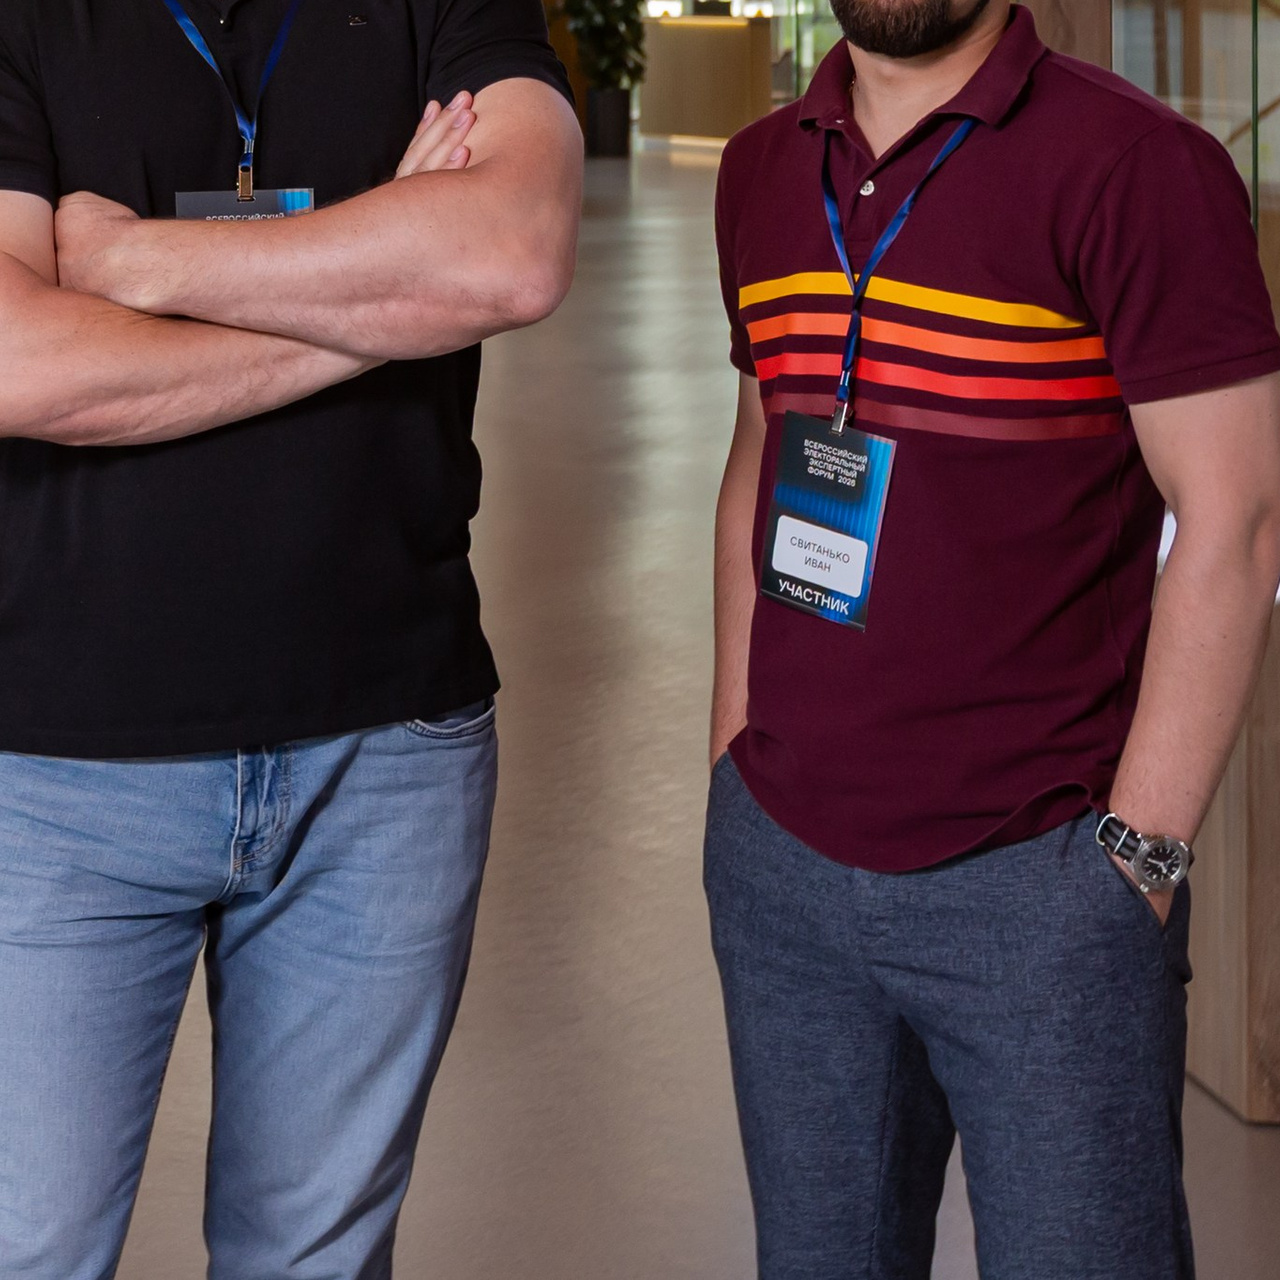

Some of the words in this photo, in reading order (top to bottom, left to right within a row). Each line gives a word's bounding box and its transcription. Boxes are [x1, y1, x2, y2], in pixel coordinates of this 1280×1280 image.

[803, 438, 868, 464] ВСЕРОССИЙСКИЙ
[803, 447, 866, 472] ЭЛЕКТОРАЛЬНЫЙ
[807, 466, 834, 480] ФОРУМ
[809, 457, 858, 478] ЭКСПЕРТНЫЙ
[789, 536, 851, 564] СВИТАНЬКО
[804, 556, 832, 573] ИВАН
[778, 578, 850, 616] УЧАСТНИК
